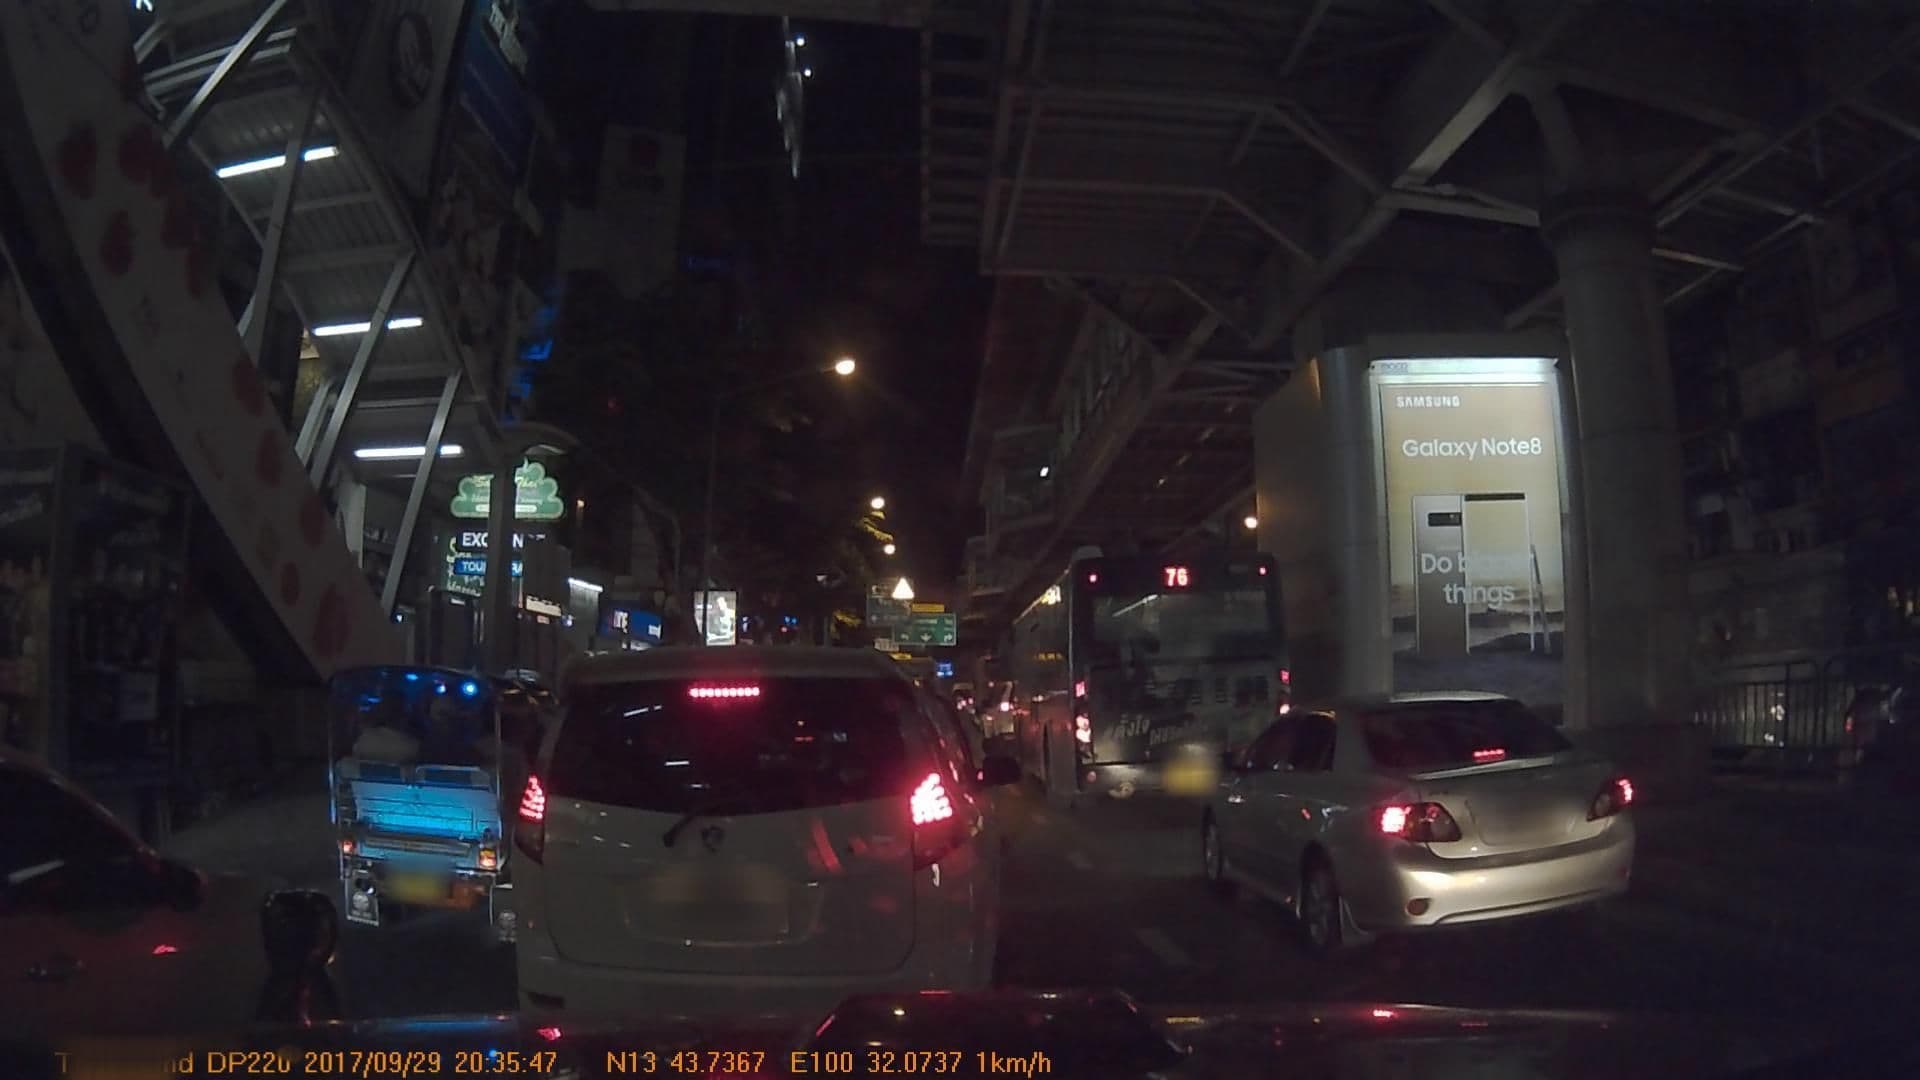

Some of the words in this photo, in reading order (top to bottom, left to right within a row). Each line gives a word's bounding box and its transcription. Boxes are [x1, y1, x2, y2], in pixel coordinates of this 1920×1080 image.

[1397, 396, 1460, 408] SAMSUNG
[1402, 438, 1479, 460] Galaxy
[1482, 437, 1542, 456] Note8
[1421, 553, 1452, 574] Do
[1165, 567, 1189, 587] 76
[1442, 583, 1515, 610] things
